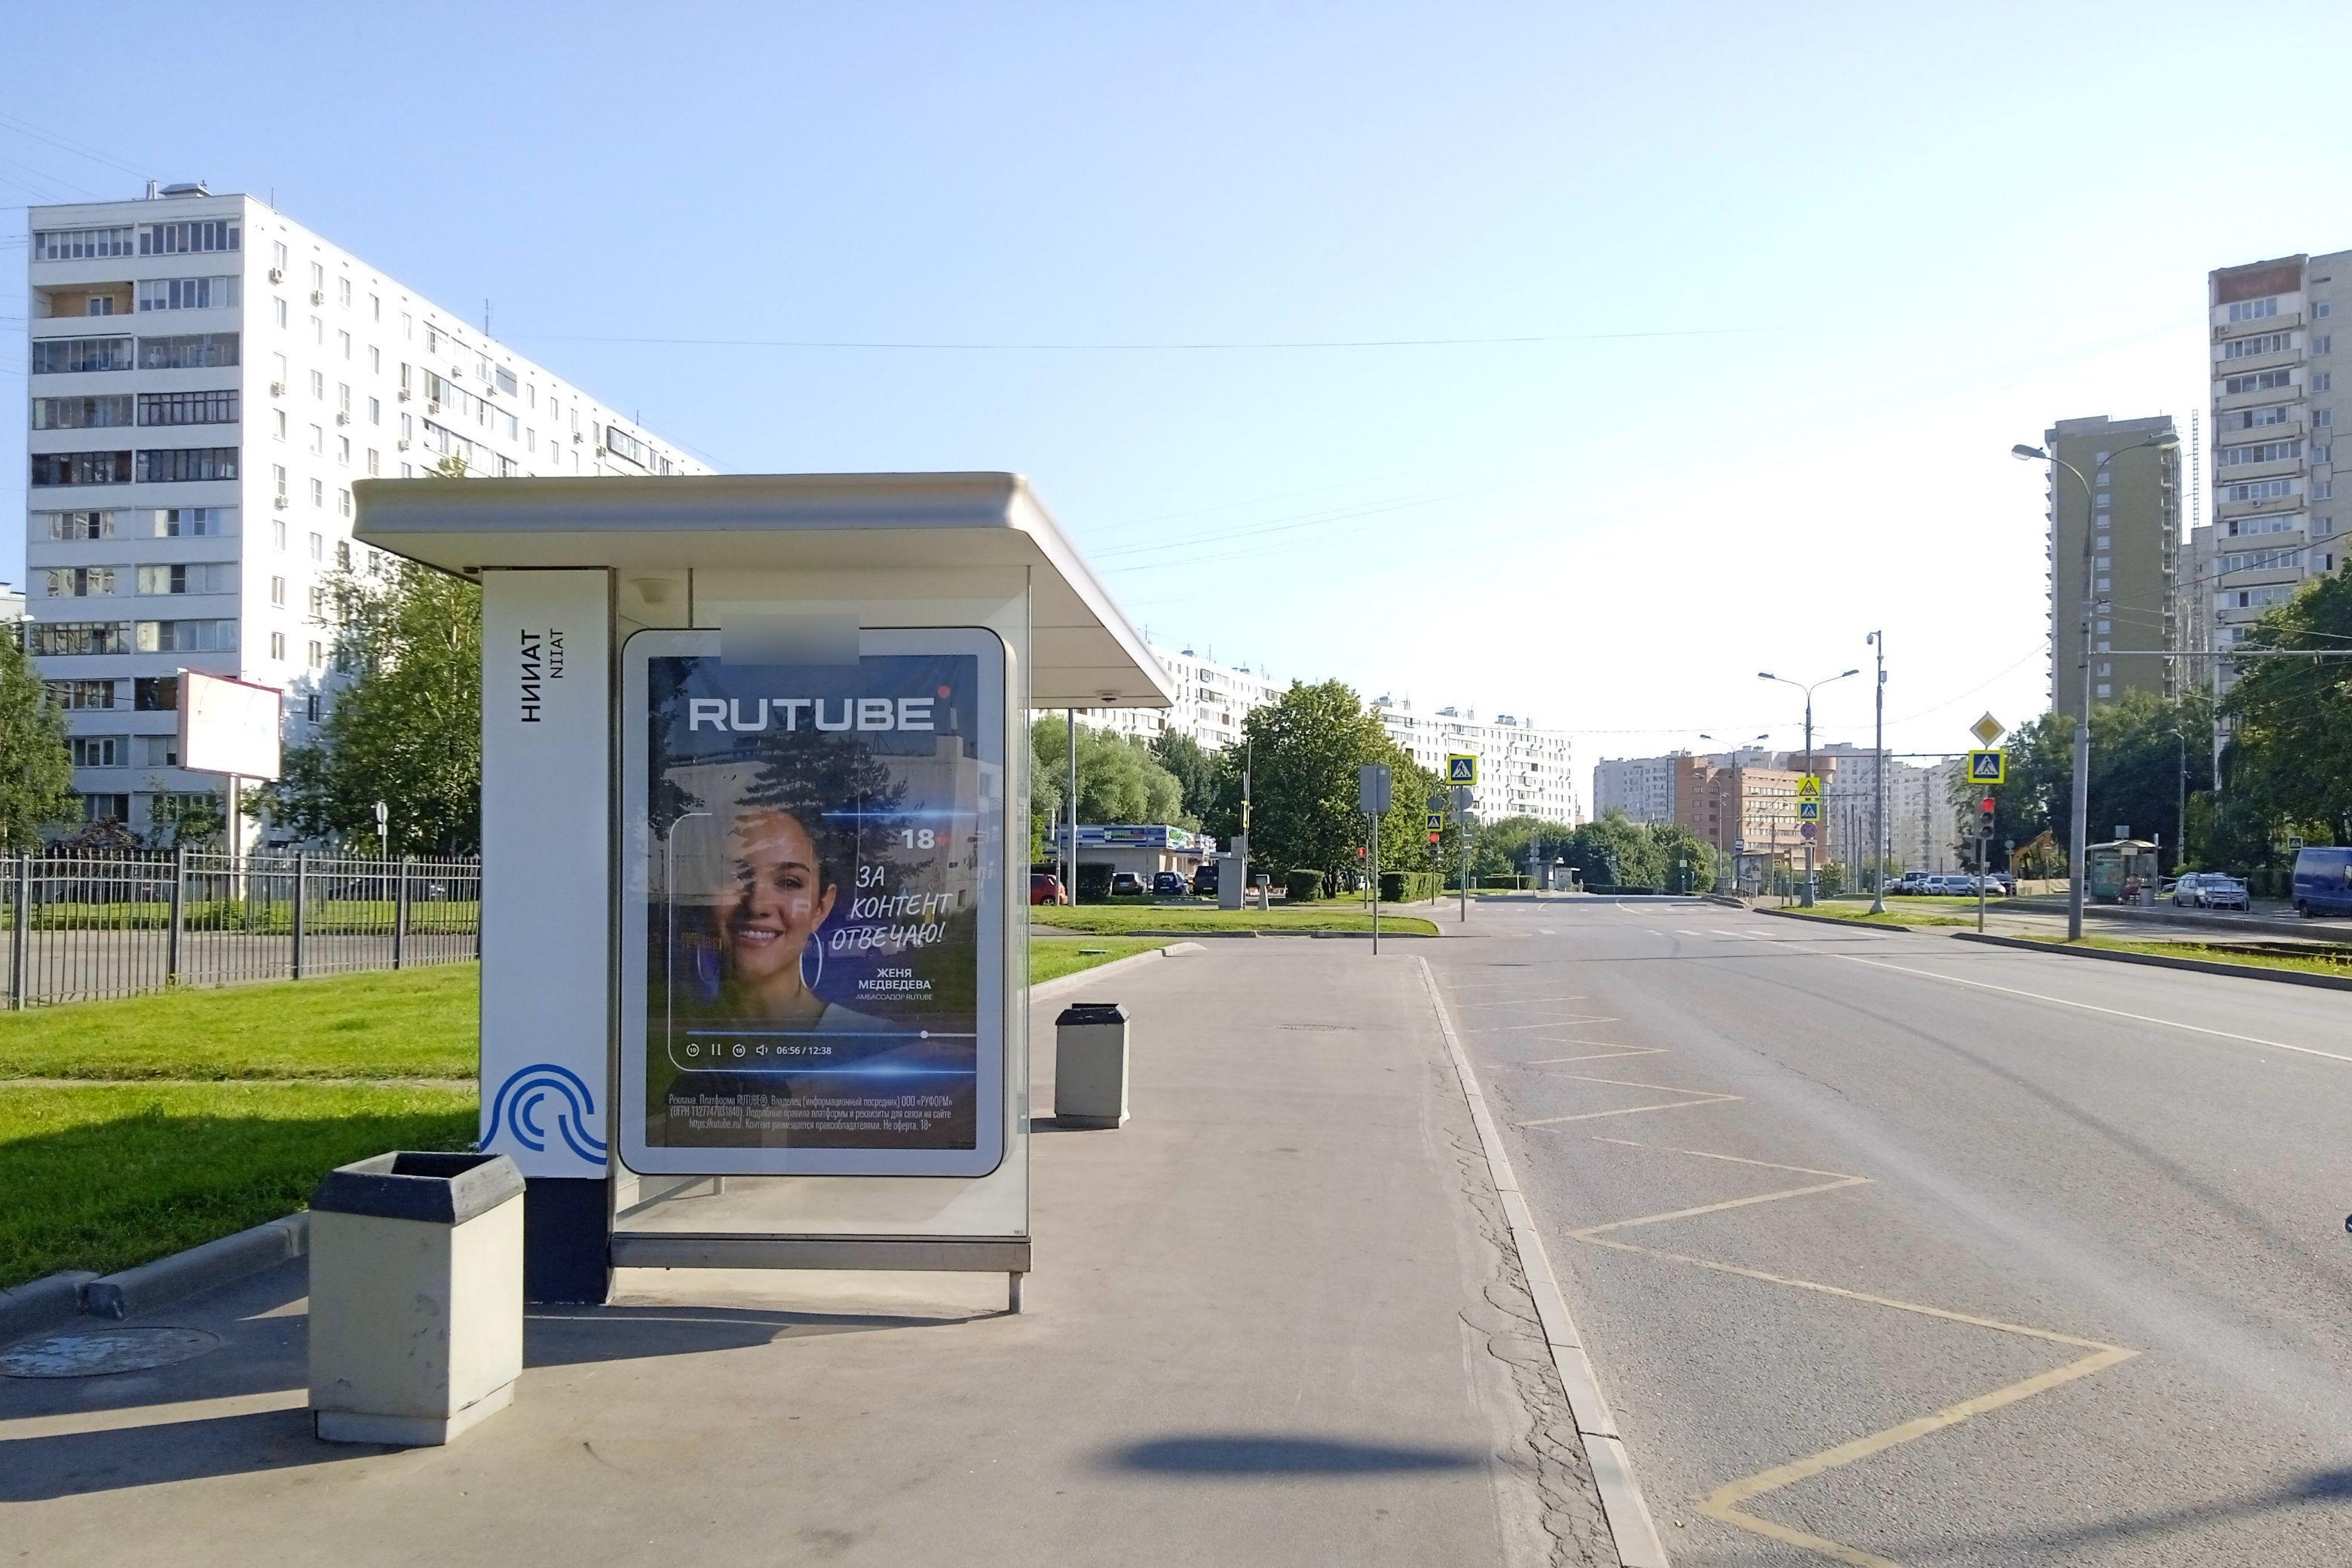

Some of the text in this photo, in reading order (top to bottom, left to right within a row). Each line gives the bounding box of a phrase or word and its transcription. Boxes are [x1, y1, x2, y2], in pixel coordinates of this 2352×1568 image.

[550, 628, 564, 678] NIIAT
[521, 629, 541, 722] НИИАТ
[689, 697, 935, 732] RUTUBE
[856, 865, 885, 888] ЗА
[850, 892, 954, 920] КОНТЕНТ
[831, 921, 946, 951] ОТВЕЧАЮ!
[877, 969, 912, 978] ЖЕНЯ
[859, 980, 932, 991] МЕДВЕДЕВА
[856, 993, 933, 1001] АМБАССАДОР RUTUBE
[776, 1046, 801, 1055] 06:56
[808, 1046, 832, 1055] 12:38
[700, 1094, 736, 1106] Платформа
[811, 1107, 848, 1120] платформы
[856, 1110, 890, 1120] реквизиты
